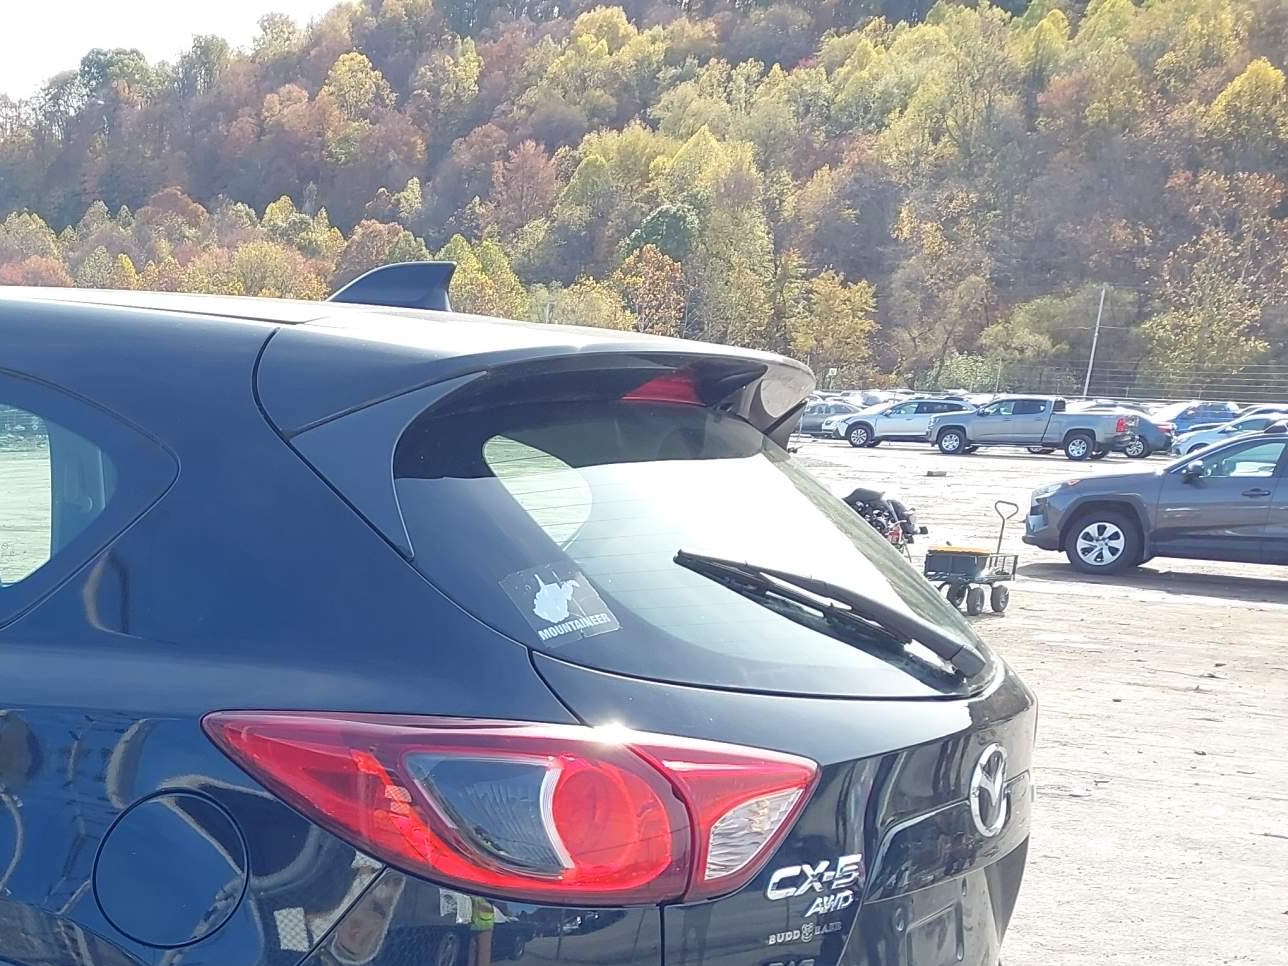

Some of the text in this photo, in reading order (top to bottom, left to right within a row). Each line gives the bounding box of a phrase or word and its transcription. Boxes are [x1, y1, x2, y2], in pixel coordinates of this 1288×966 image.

[537, 612, 611, 641] MOUNTAINEER
[767, 853, 862, 900] CX-5
[804, 889, 854, 918] AWD
[768, 930, 800, 945] BUDD
